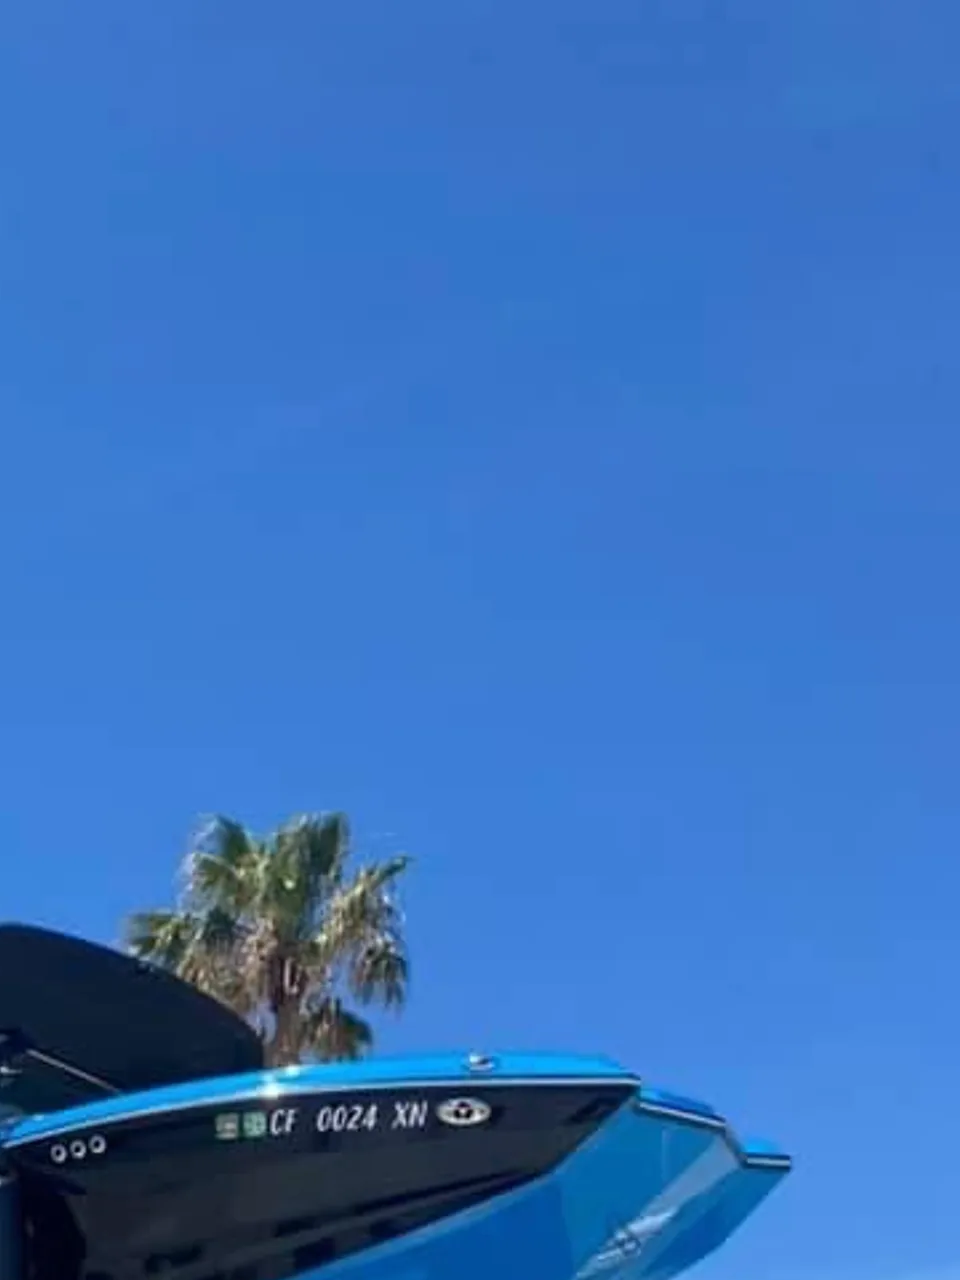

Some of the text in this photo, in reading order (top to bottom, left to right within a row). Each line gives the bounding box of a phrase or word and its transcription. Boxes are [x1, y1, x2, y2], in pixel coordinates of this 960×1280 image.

[269, 1108, 297, 1136] CF
[316, 1103, 377, 1133] 0024
[391, 1099, 429, 1129] XN
